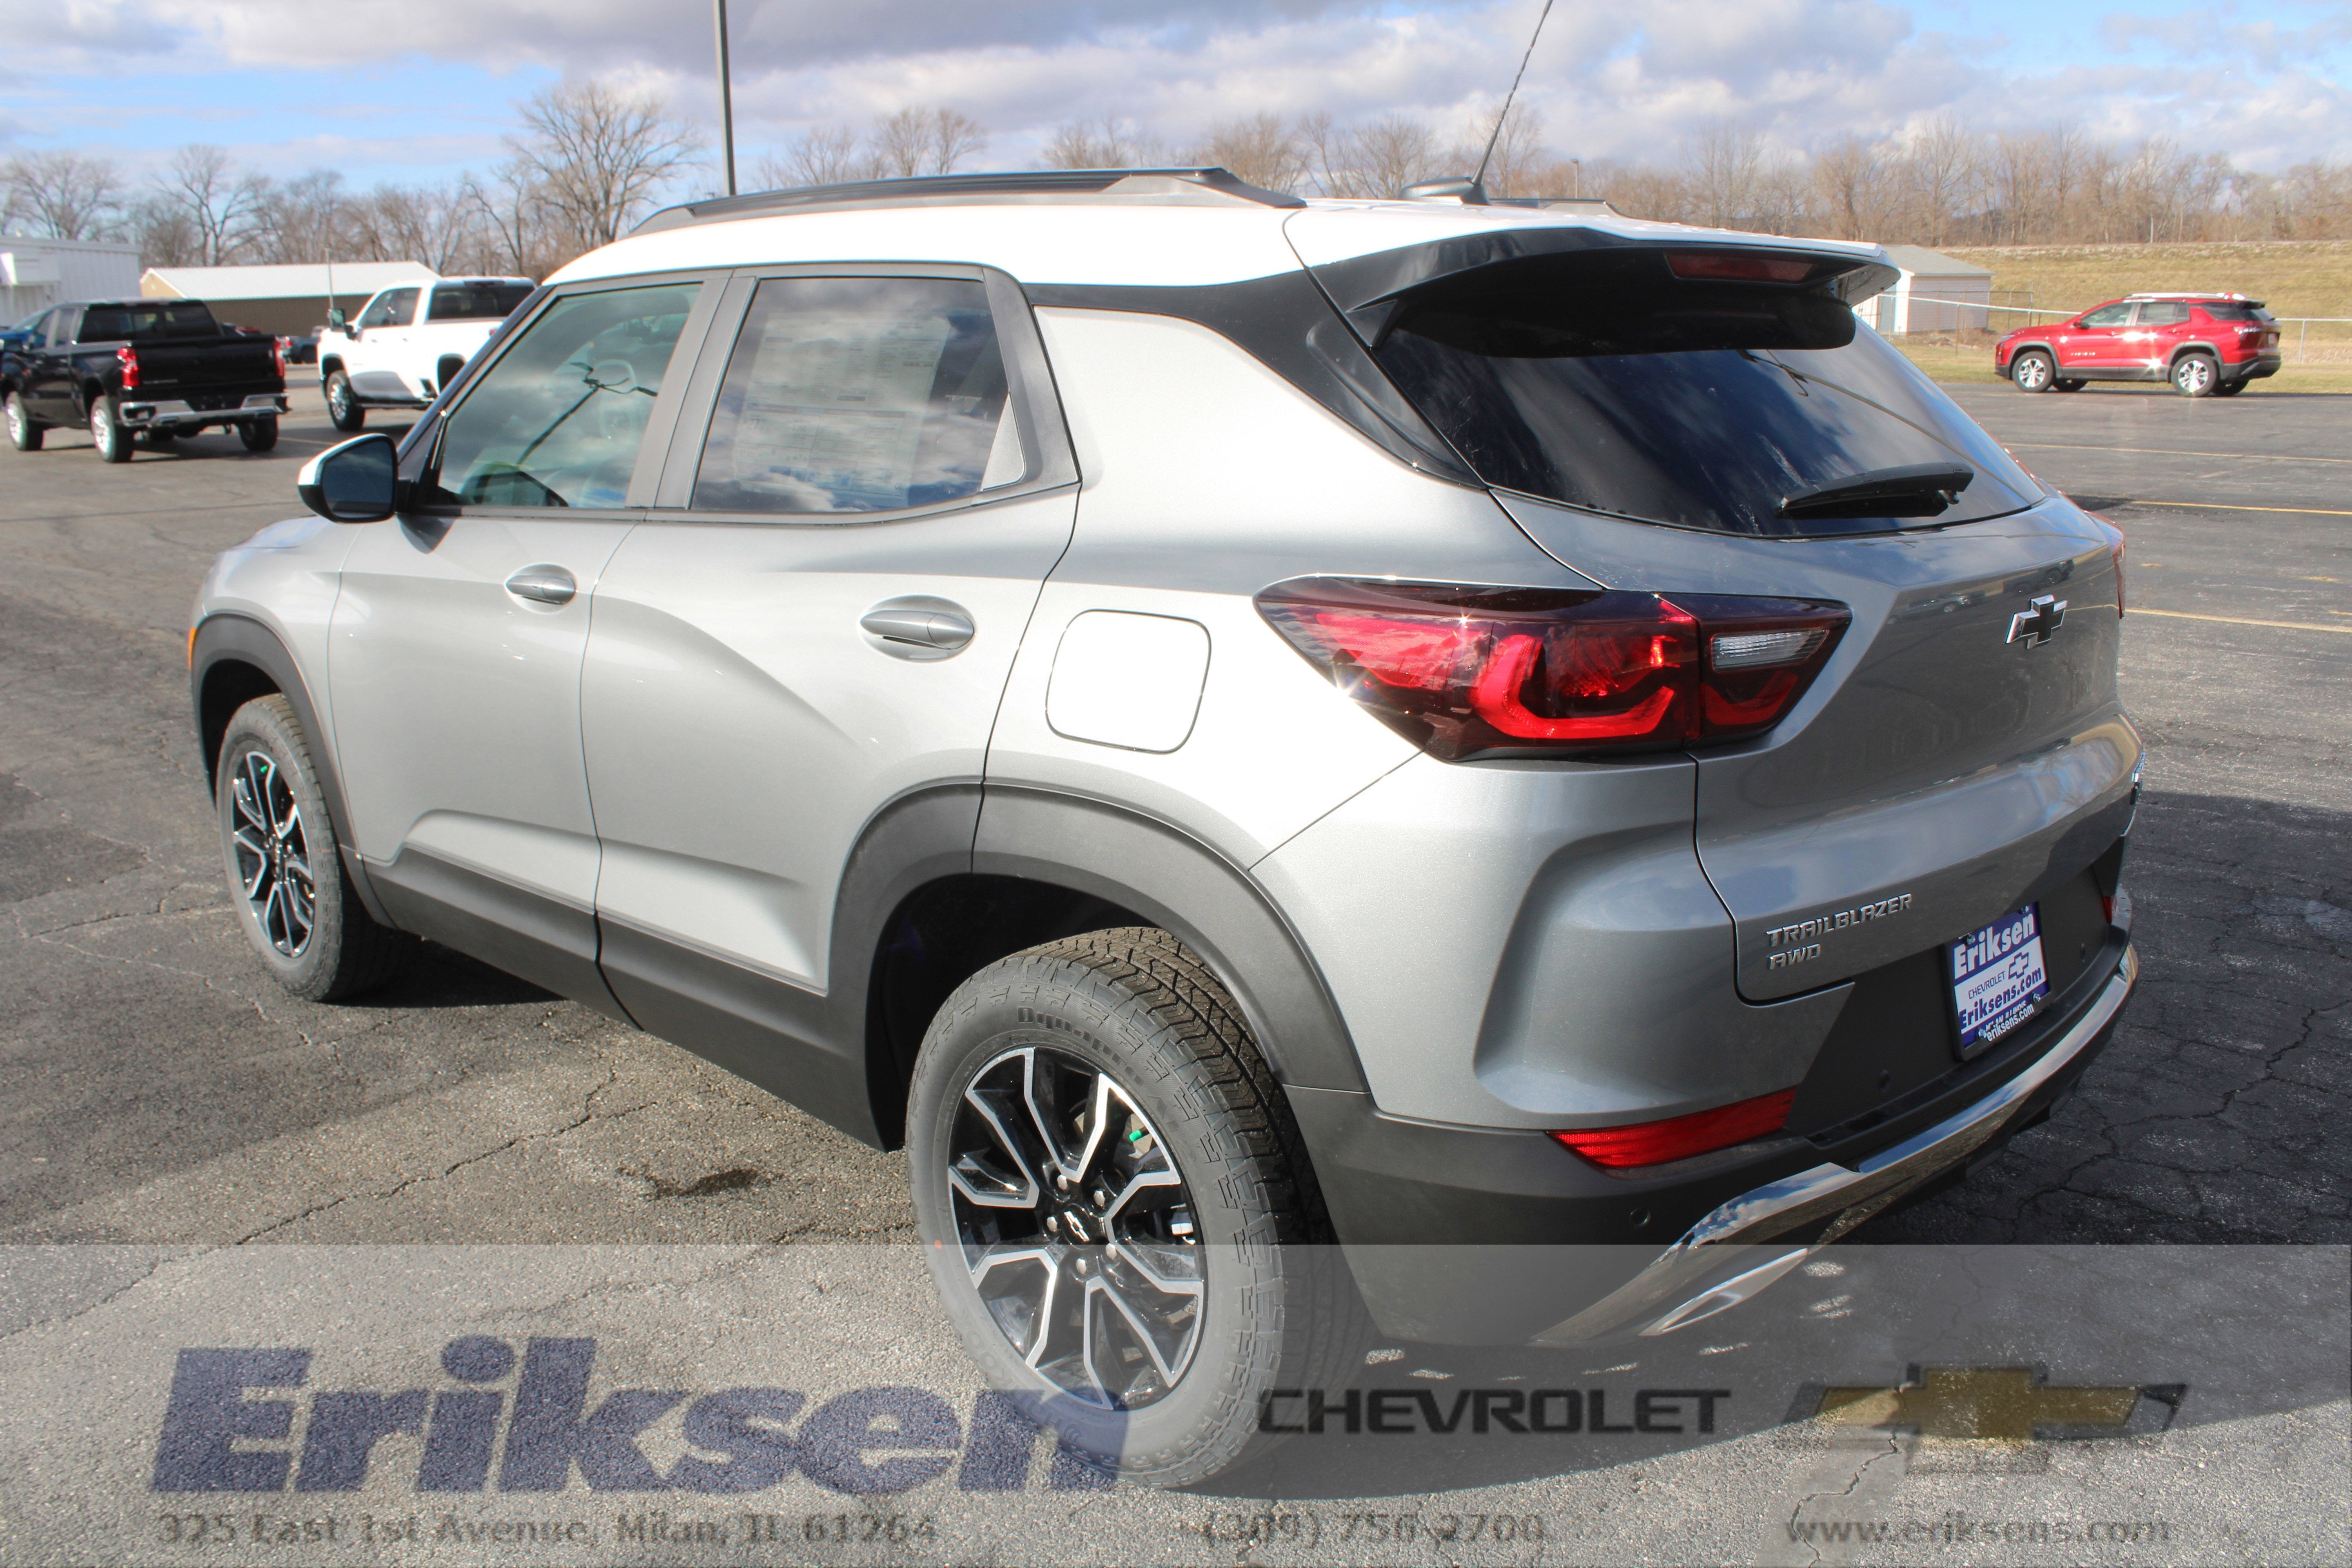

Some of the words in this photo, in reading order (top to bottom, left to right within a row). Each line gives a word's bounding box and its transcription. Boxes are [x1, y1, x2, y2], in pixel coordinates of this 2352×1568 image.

[1765, 893, 1913, 947] TRAILBLAZER
[1954, 913, 2035, 980] Eriksen
[1768, 944, 1821, 970] AWD
[1959, 967, 2042, 1029] Eriksens.com
[1968, 970, 2006, 999] CHEVROLET
[1018, 1006, 1143, 1086] Dynapro
[1987, 1003, 2034, 1042] eriksens.com
